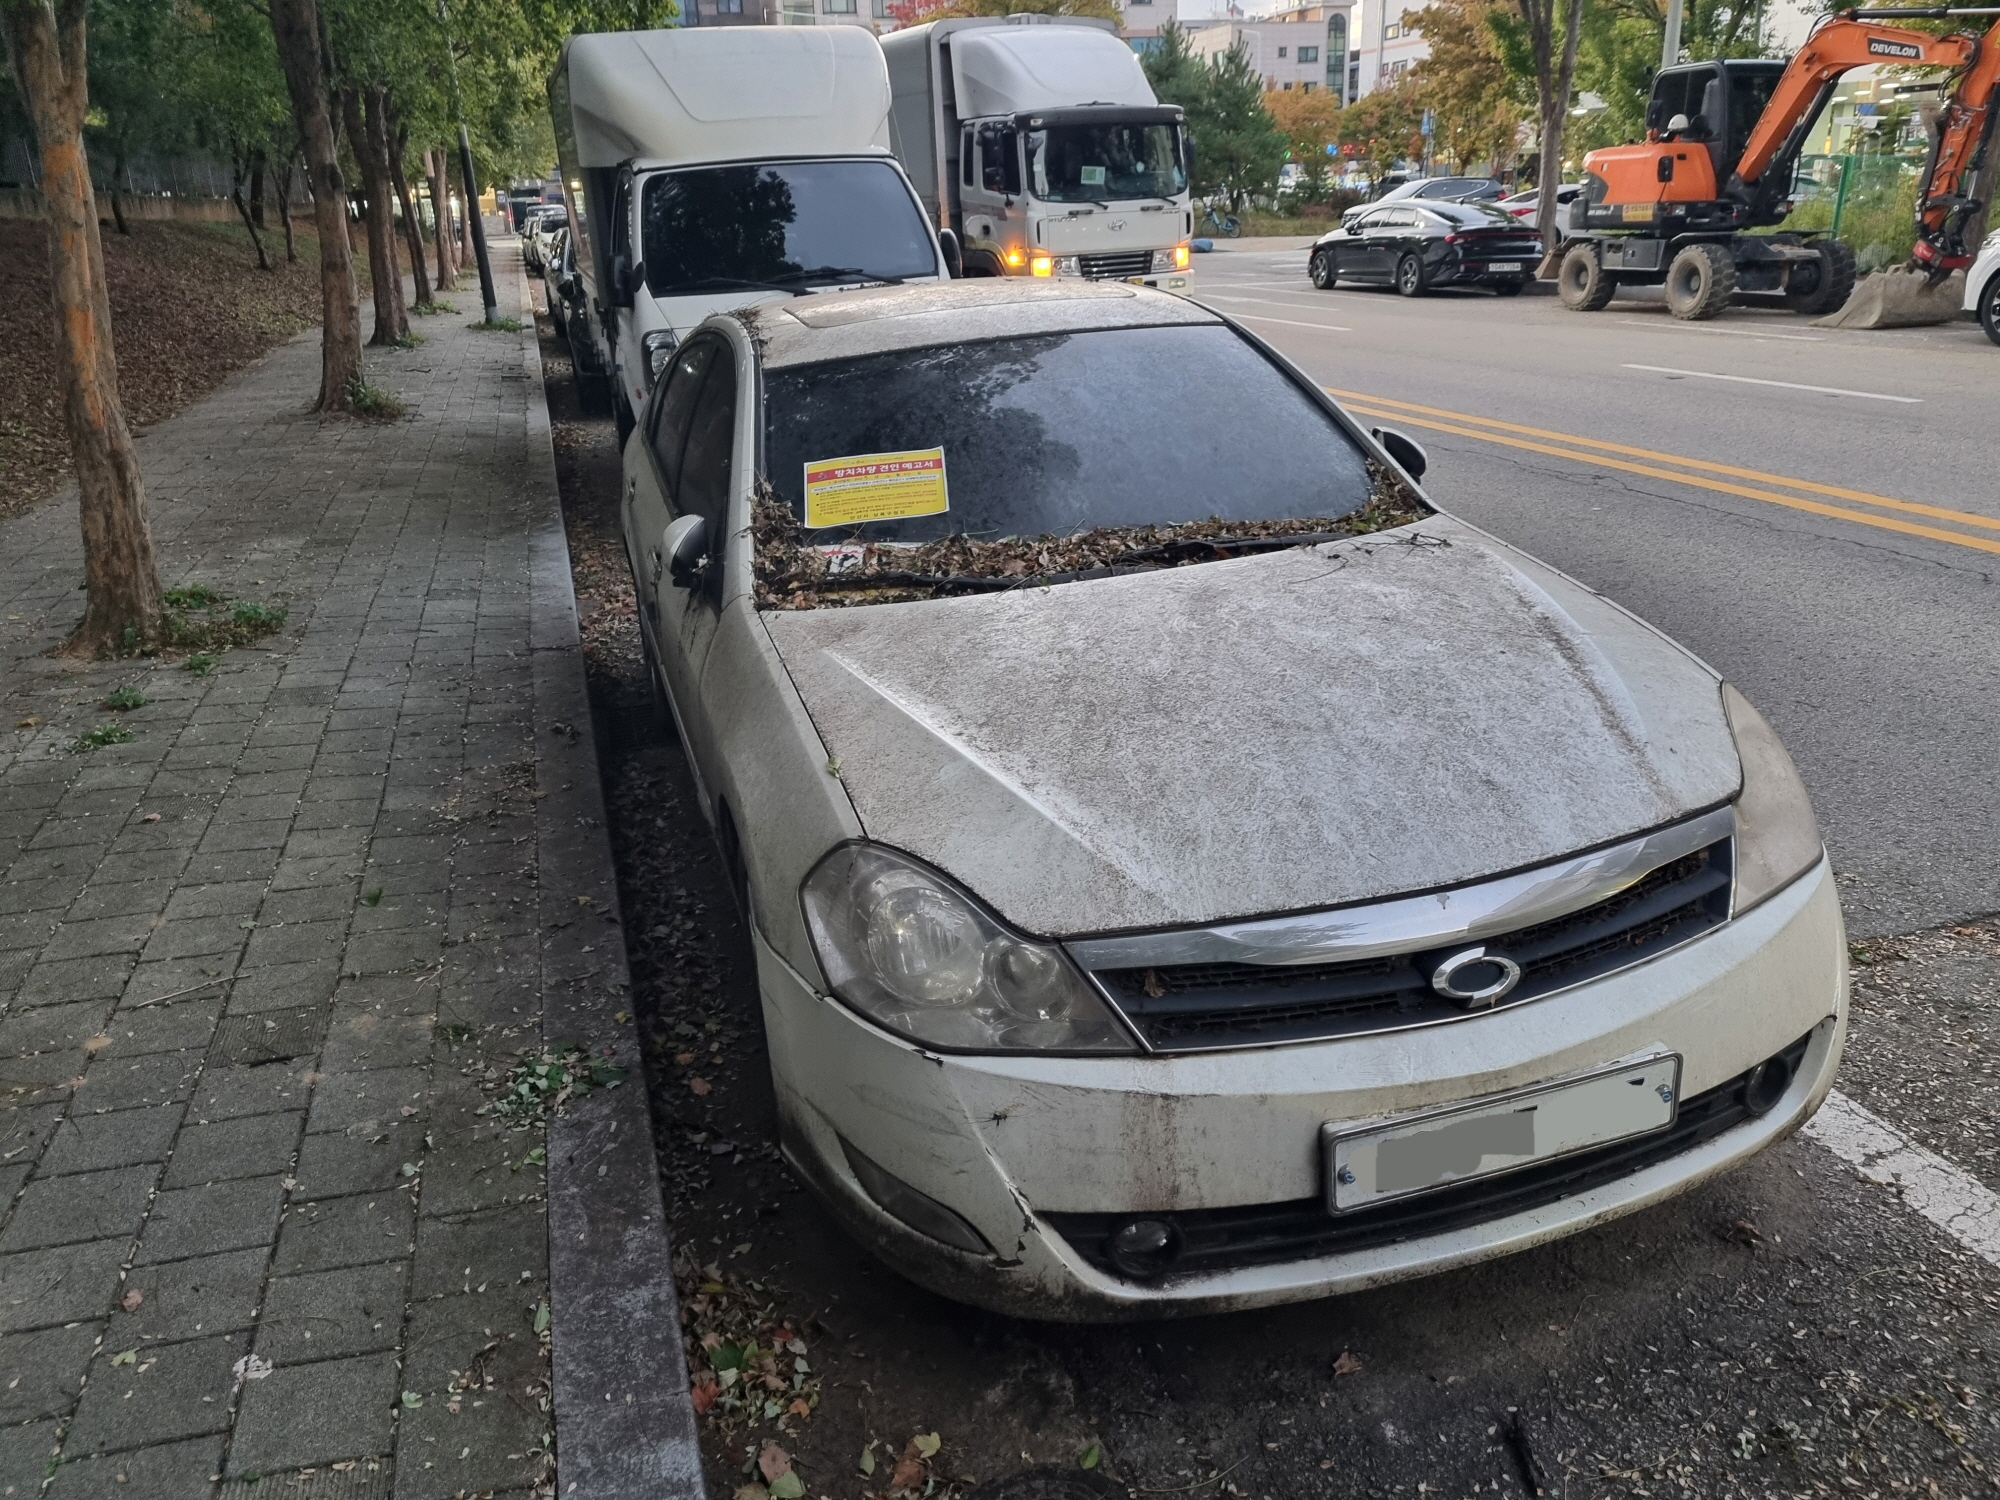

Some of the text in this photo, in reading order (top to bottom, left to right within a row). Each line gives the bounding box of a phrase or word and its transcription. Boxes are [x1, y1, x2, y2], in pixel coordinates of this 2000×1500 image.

[1870, 42, 1917, 57] DEVELON
[834, 465, 877, 478] 방치차량
[880, 463, 900, 473] 견인
[902, 460, 934, 470] 예고서
